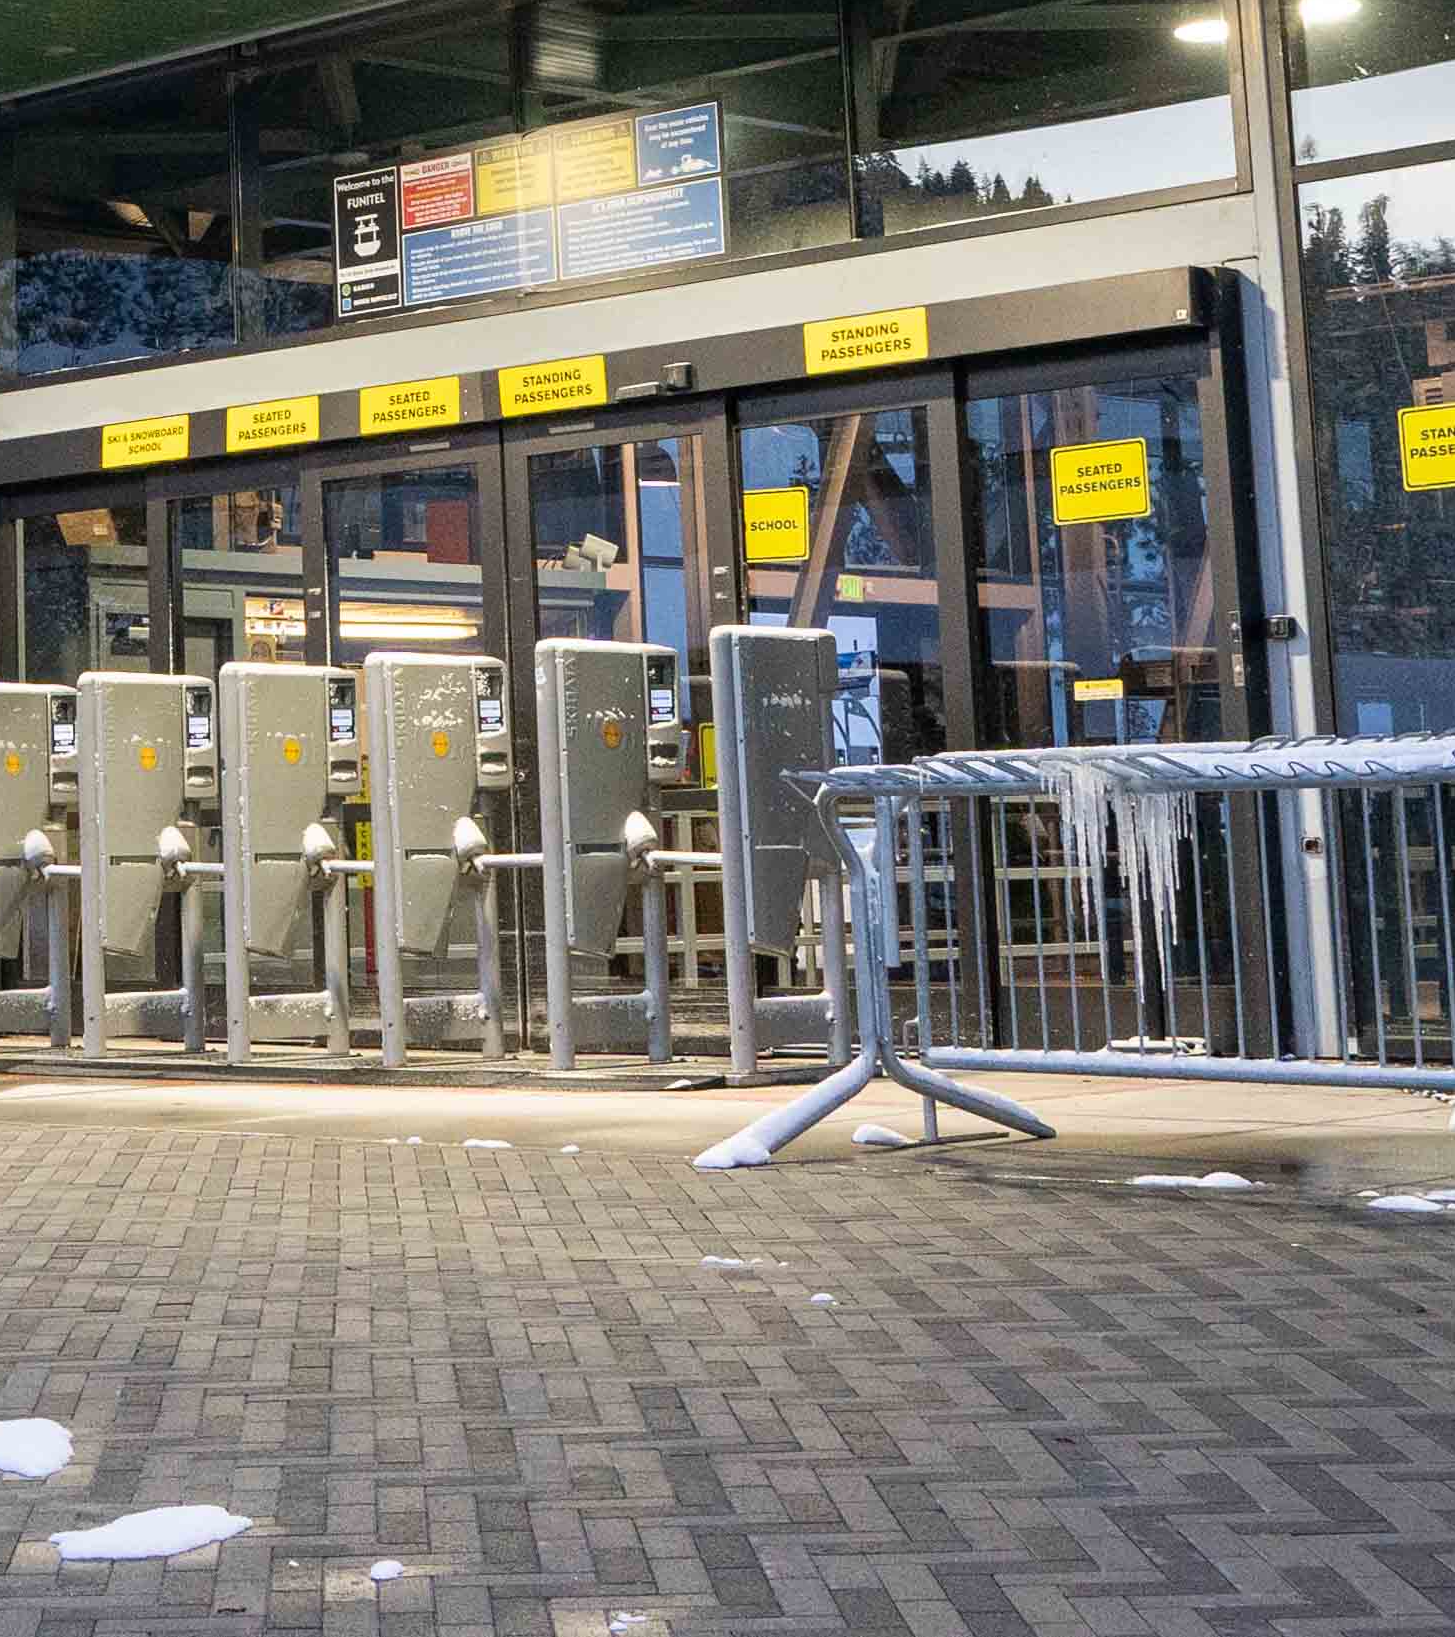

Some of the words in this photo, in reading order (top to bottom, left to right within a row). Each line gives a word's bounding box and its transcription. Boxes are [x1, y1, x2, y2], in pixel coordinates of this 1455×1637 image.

[422, 162, 451, 173] DANGER
[337, 179, 371, 192] Welcome
[372, 177, 380, 186] to
[381, 174, 394, 185] the
[347, 192, 386, 210] FUNITEL
[831, 322, 899, 343] STANDING
[821, 338, 912, 361] PASSENGERS
[522, 369, 581, 387] STANDING
[389, 391, 430, 406] SEATED
[515, 384, 592, 405] PASSENGERS
[253, 410, 291, 424] SEATED
[373, 404, 447, 423] PASSENGERS
[107, 433, 121, 444] SKI
[130, 426, 184, 442] SNOWBOARD
[239, 423, 307, 441] PASSENGERS
[128, 442, 162, 454] SCHOOL
[1077, 463, 1122, 477] SEATED
[1059, 476, 1141, 495] PASSENGERS
[750, 519, 798, 531] SCHOOL
